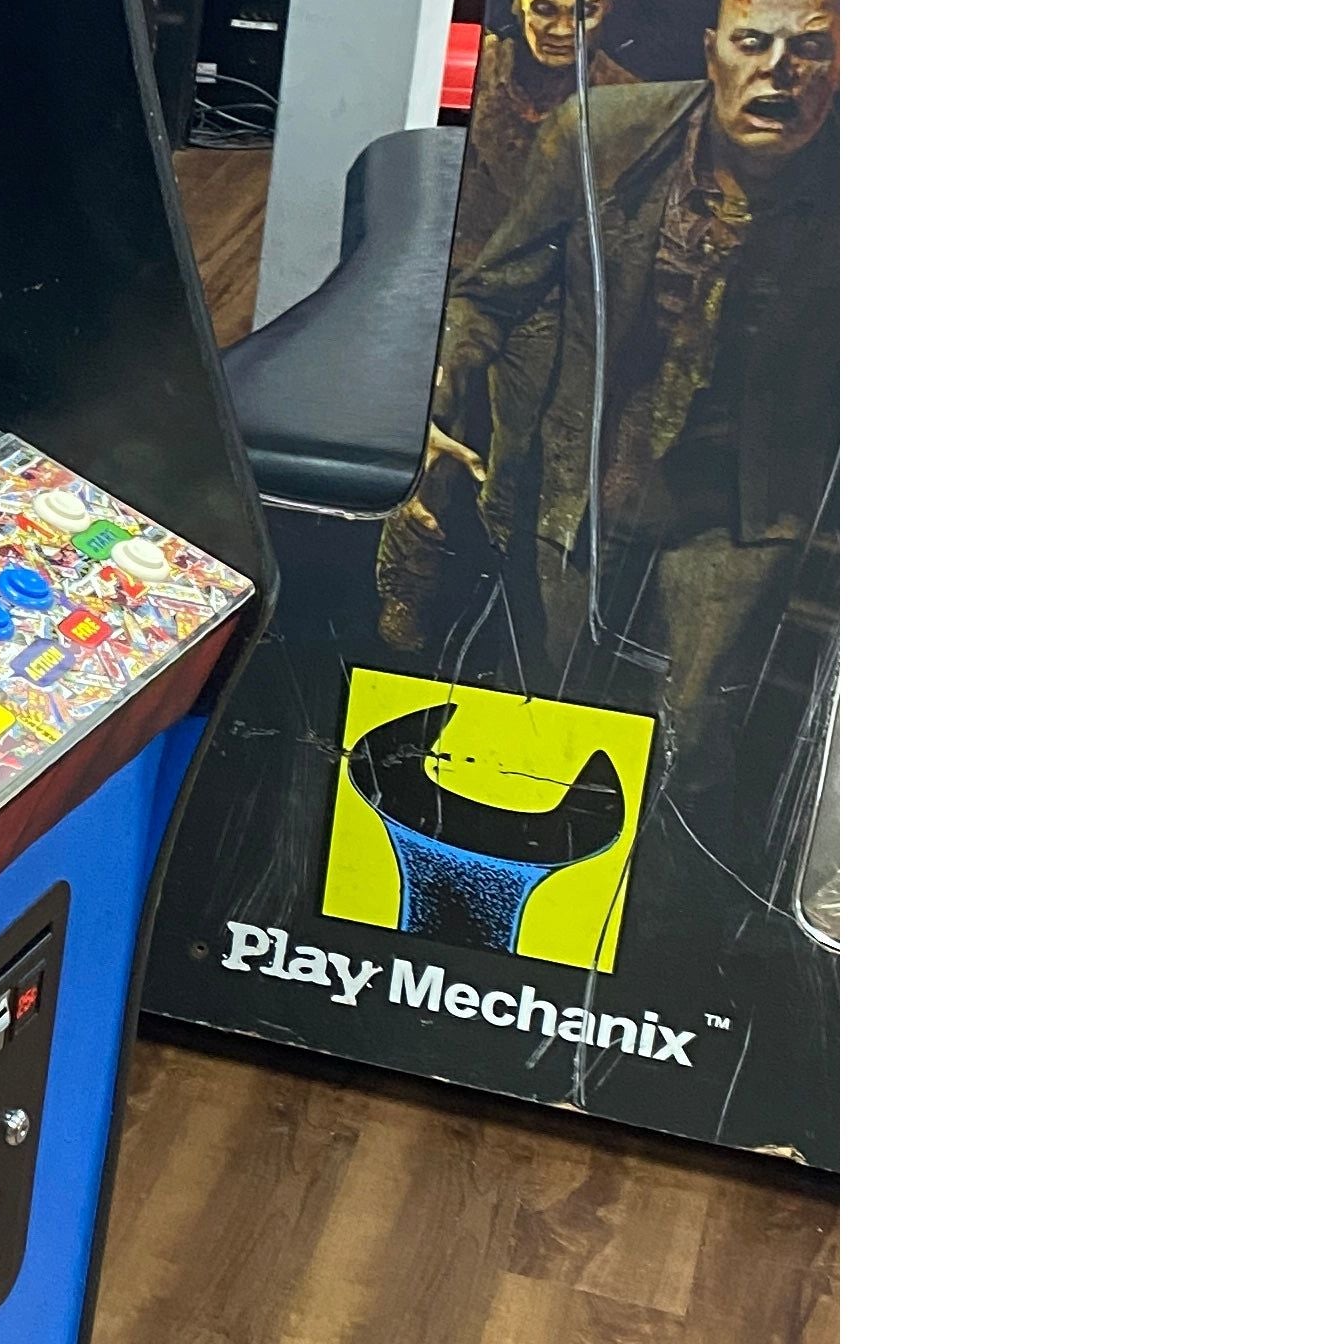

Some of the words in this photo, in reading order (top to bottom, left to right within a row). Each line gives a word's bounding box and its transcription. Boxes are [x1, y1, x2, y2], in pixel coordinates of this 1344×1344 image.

[86, 526, 117, 554] START
[70, 616, 101, 642] FIRE
[25, 645, 66, 682] ACTION
[220, 920, 383, 1006] Play
[387, 958, 697, 1067] Mechanix
